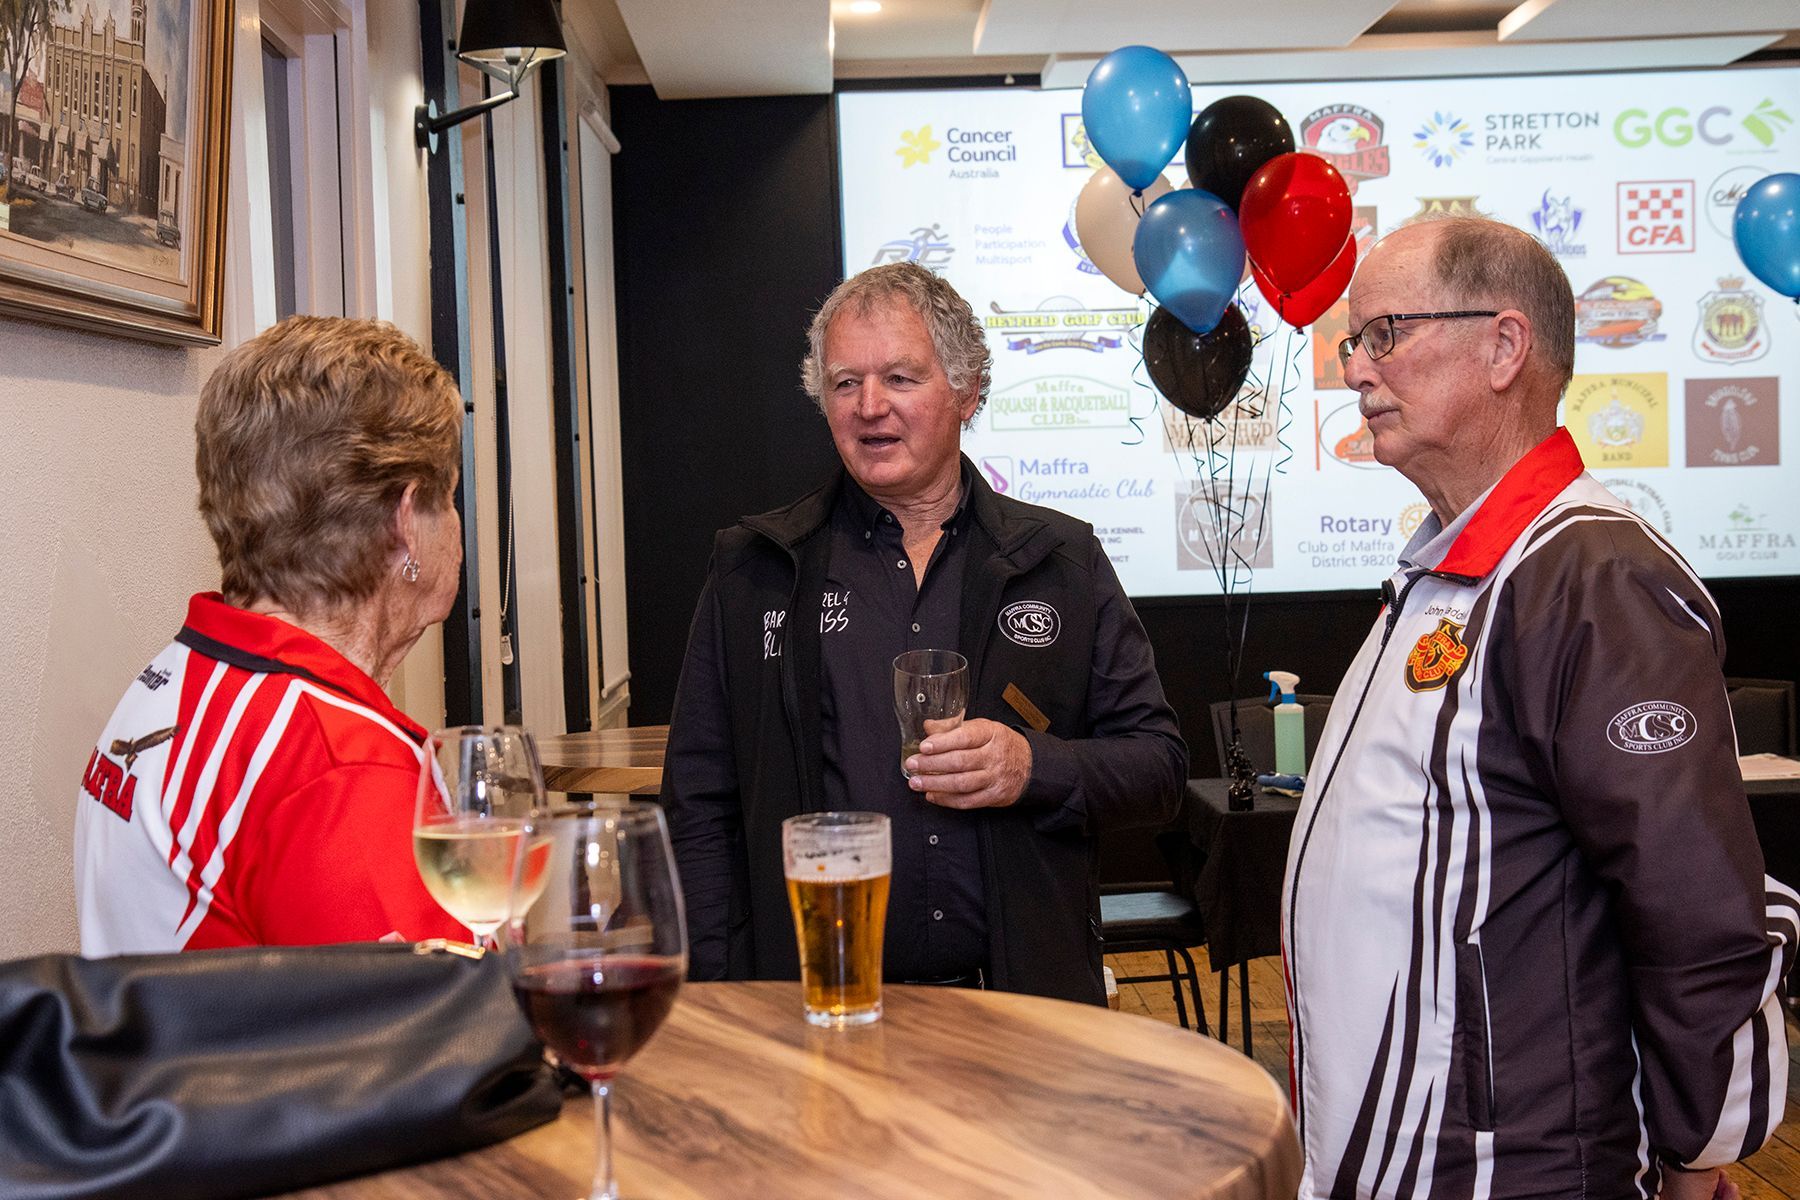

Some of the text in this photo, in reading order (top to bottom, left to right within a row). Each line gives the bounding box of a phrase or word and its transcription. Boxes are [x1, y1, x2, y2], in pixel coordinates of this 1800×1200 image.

[1485, 111, 1599, 131] STRETTON
[1613, 106, 1734, 148] GGC
[947, 128, 1012, 144] Cancer
[1486, 133, 1542, 150] PARK
[947, 145, 1016, 162] Council
[949, 168, 1000, 179] Australia
[974, 224, 1013, 236] People
[1628, 225, 1685, 246] CFA
[975, 239, 1046, 252] Participation
[976, 254, 1032, 267] Multisport
[986, 312, 1146, 329] HEYFIELD GOLF CLUB
[1035, 382, 1085, 394] Maffra
[993, 397, 1039, 415] SQUASH
[1031, 413, 1076, 426] CLUB
[1602, 452, 1633, 462] BAND
[1020, 459, 1089, 476] Maffra
[1019, 478, 1156, 503] Gymnastic Club
[1320, 515, 1392, 536] Rotary
[1297, 539, 1395, 554] Club of Maffra
[1699, 533, 1797, 550] MAFFRA
[1311, 554, 1395, 568] District 9820
[1425, 604, 1444, 616] John
[1614, 703, 1687, 727] MAFFRA COMMUNITY
[1623, 741, 1652, 751] SPORTS
[1653, 738, 1674, 750] CLUB
